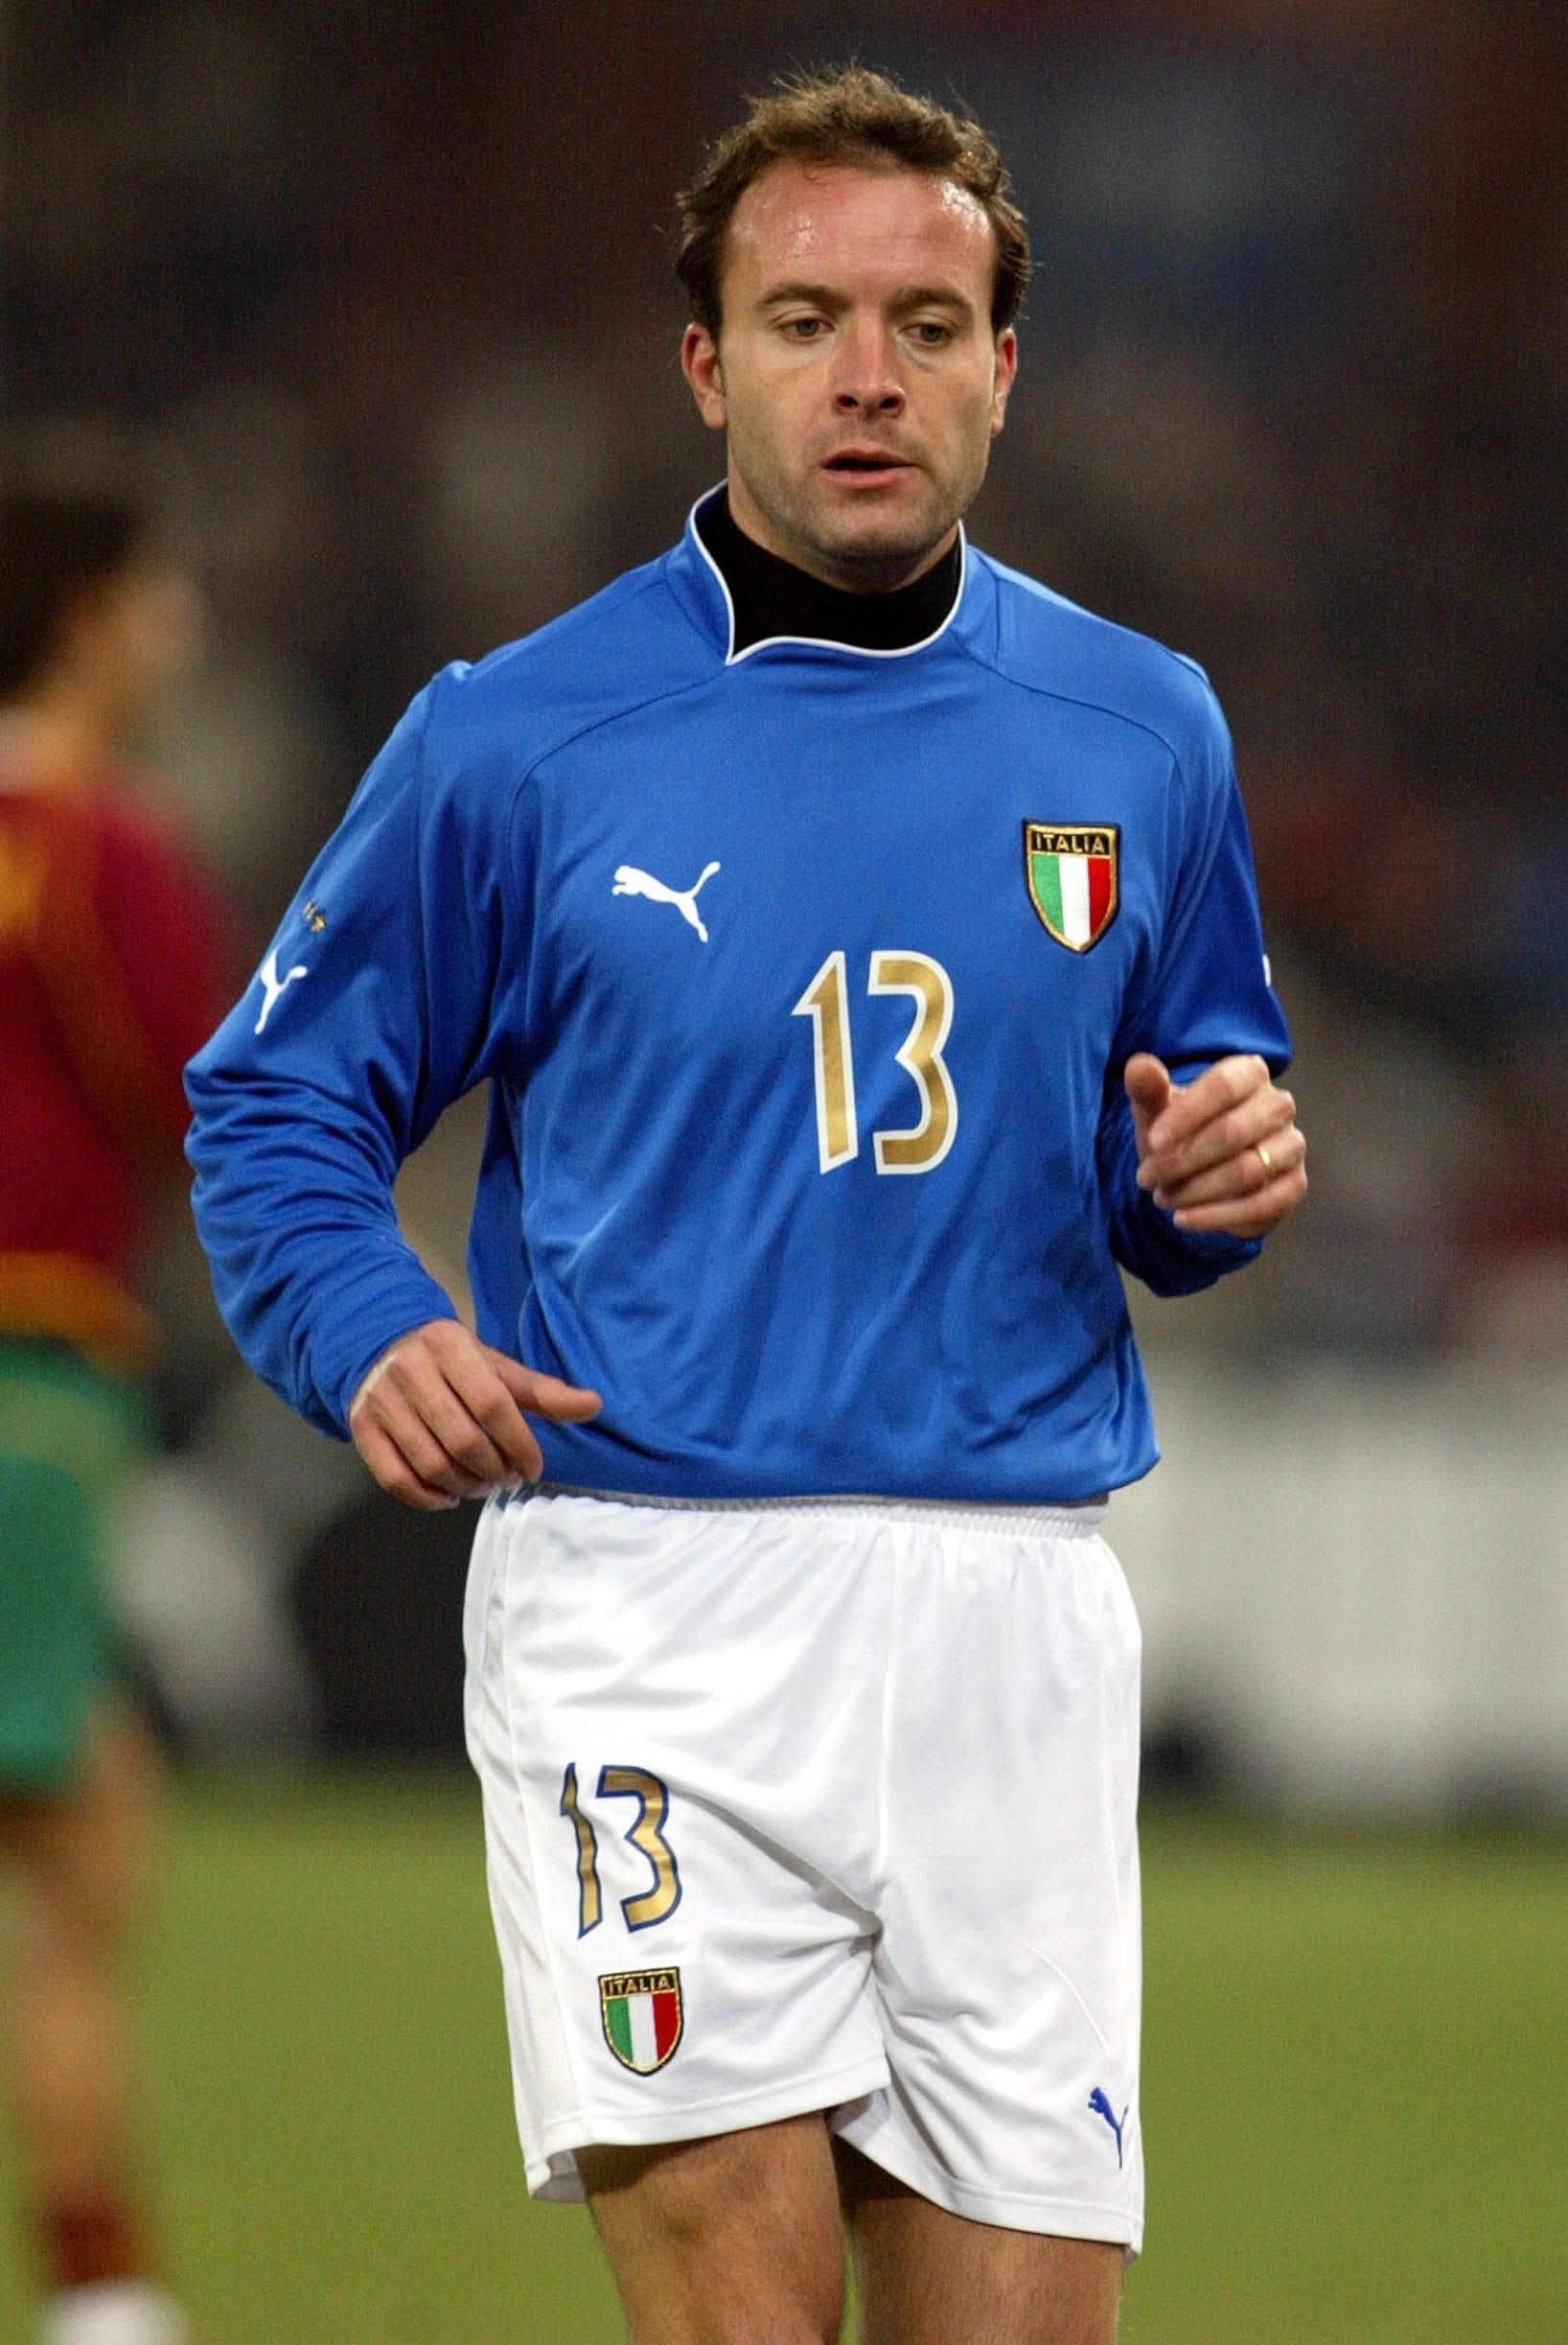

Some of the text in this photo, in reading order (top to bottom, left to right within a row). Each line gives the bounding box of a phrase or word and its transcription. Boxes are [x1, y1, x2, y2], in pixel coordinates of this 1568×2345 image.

[1035, 833, 1106, 854] ITALIA
[791, 949, 958, 1175] 13
[560, 1761, 683, 1941] 13
[608, 1975, 672, 1995] ITALIA
